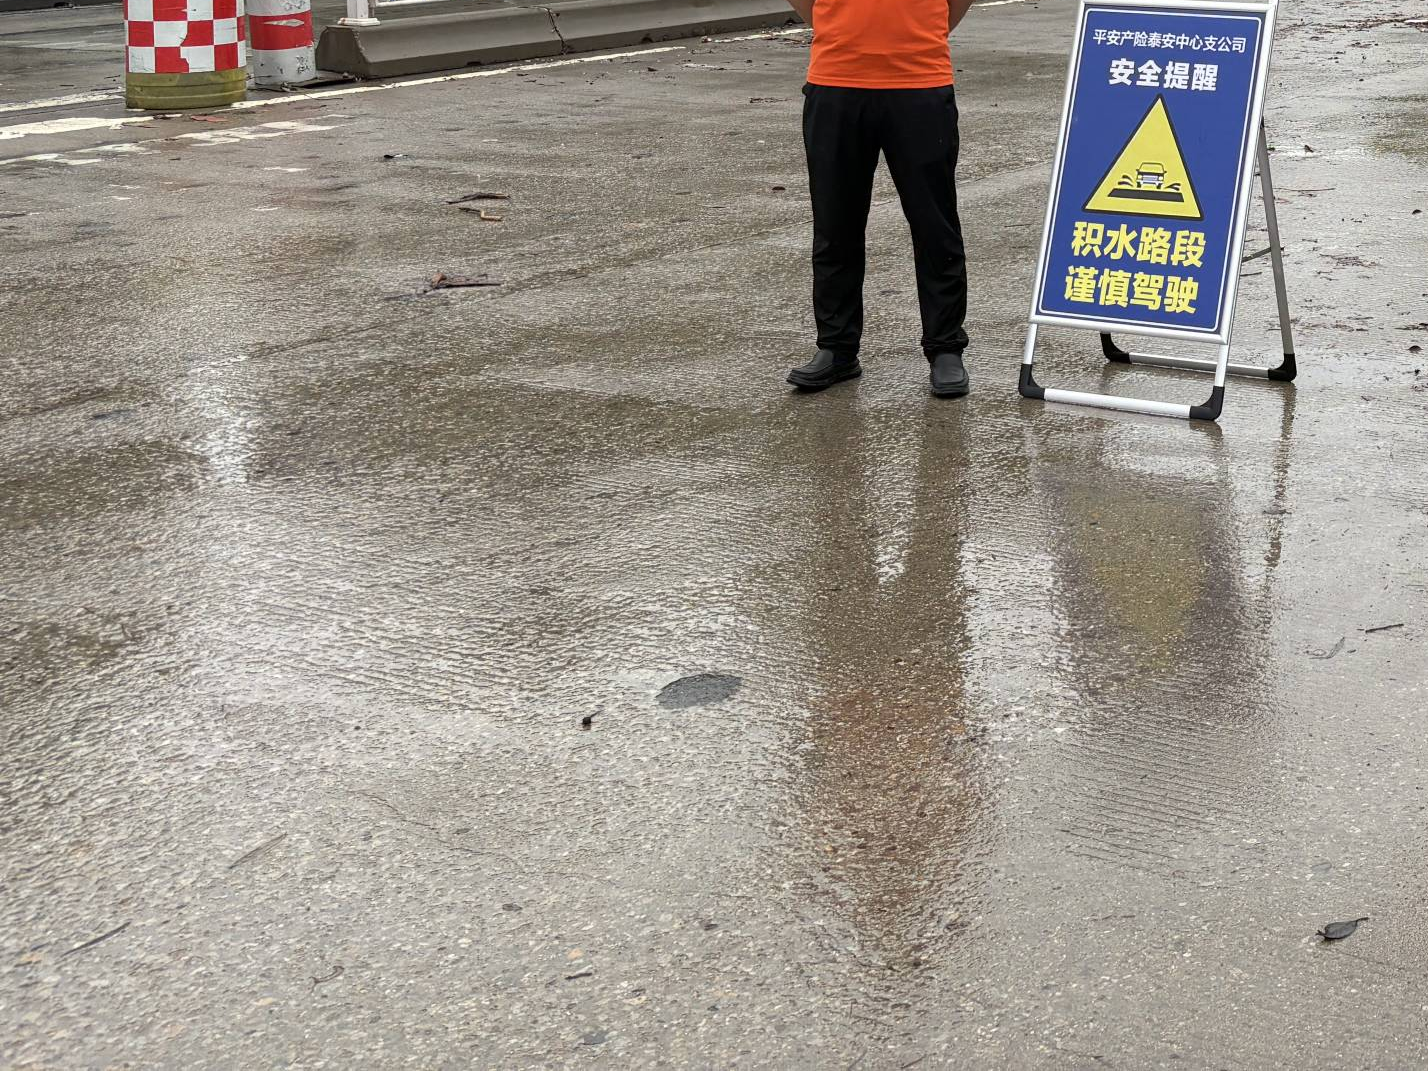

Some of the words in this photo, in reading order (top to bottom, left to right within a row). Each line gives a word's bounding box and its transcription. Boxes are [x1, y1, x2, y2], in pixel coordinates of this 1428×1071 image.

[1092, 28, 1247, 54] 平安产险泰安中心支公司
[1108, 57, 1219, 92] 安全提醒
[1071, 220, 1207, 268] 积水路段
[1063, 265, 1200, 315] 谨慎驾驶
